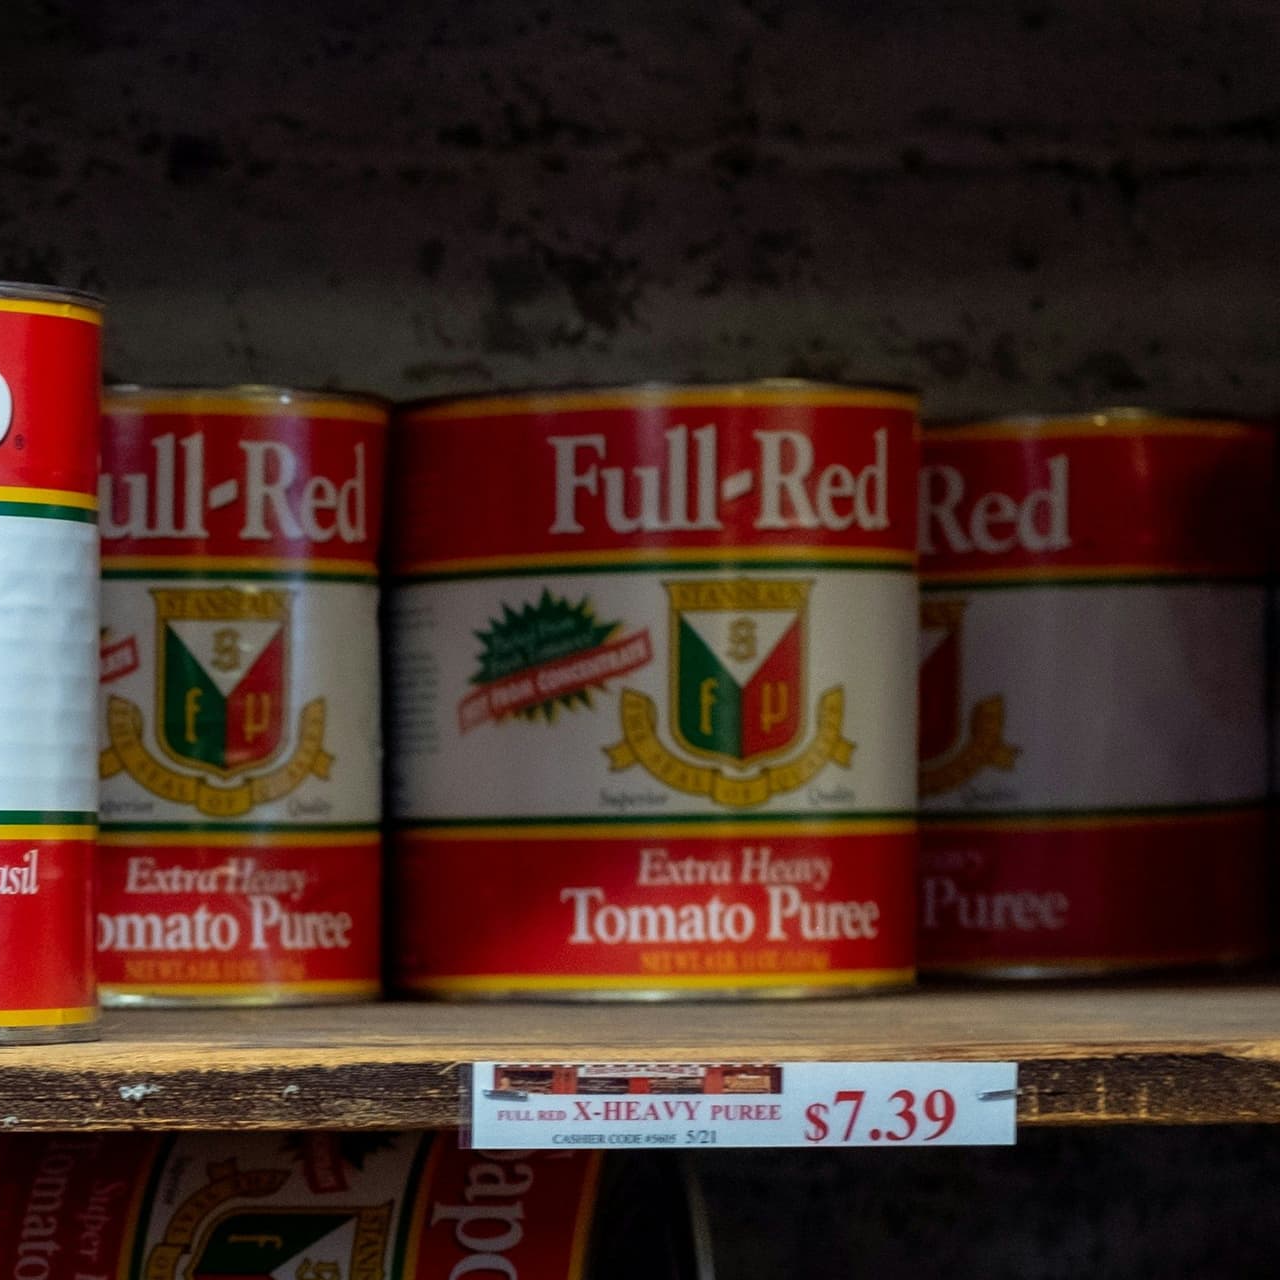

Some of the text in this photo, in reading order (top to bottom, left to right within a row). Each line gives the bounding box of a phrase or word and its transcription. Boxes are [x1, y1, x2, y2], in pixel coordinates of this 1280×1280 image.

[99, 431, 367, 544] ull-Red
[547, 424, 889, 535] Full-Red
[636, 847, 831, 890] Extra Heavy
[98, 896, 352, 952] omato Puree
[560, 883, 879, 944] Tomato Puree
[497, 1087, 956, 1143] FULL RED X-HEAVY PUREE $7.39
[552, 1134, 605, 1144] CASHIER
[611, 1134, 641, 1144] CODE
[685, 1130, 717, 1143] 5/21
